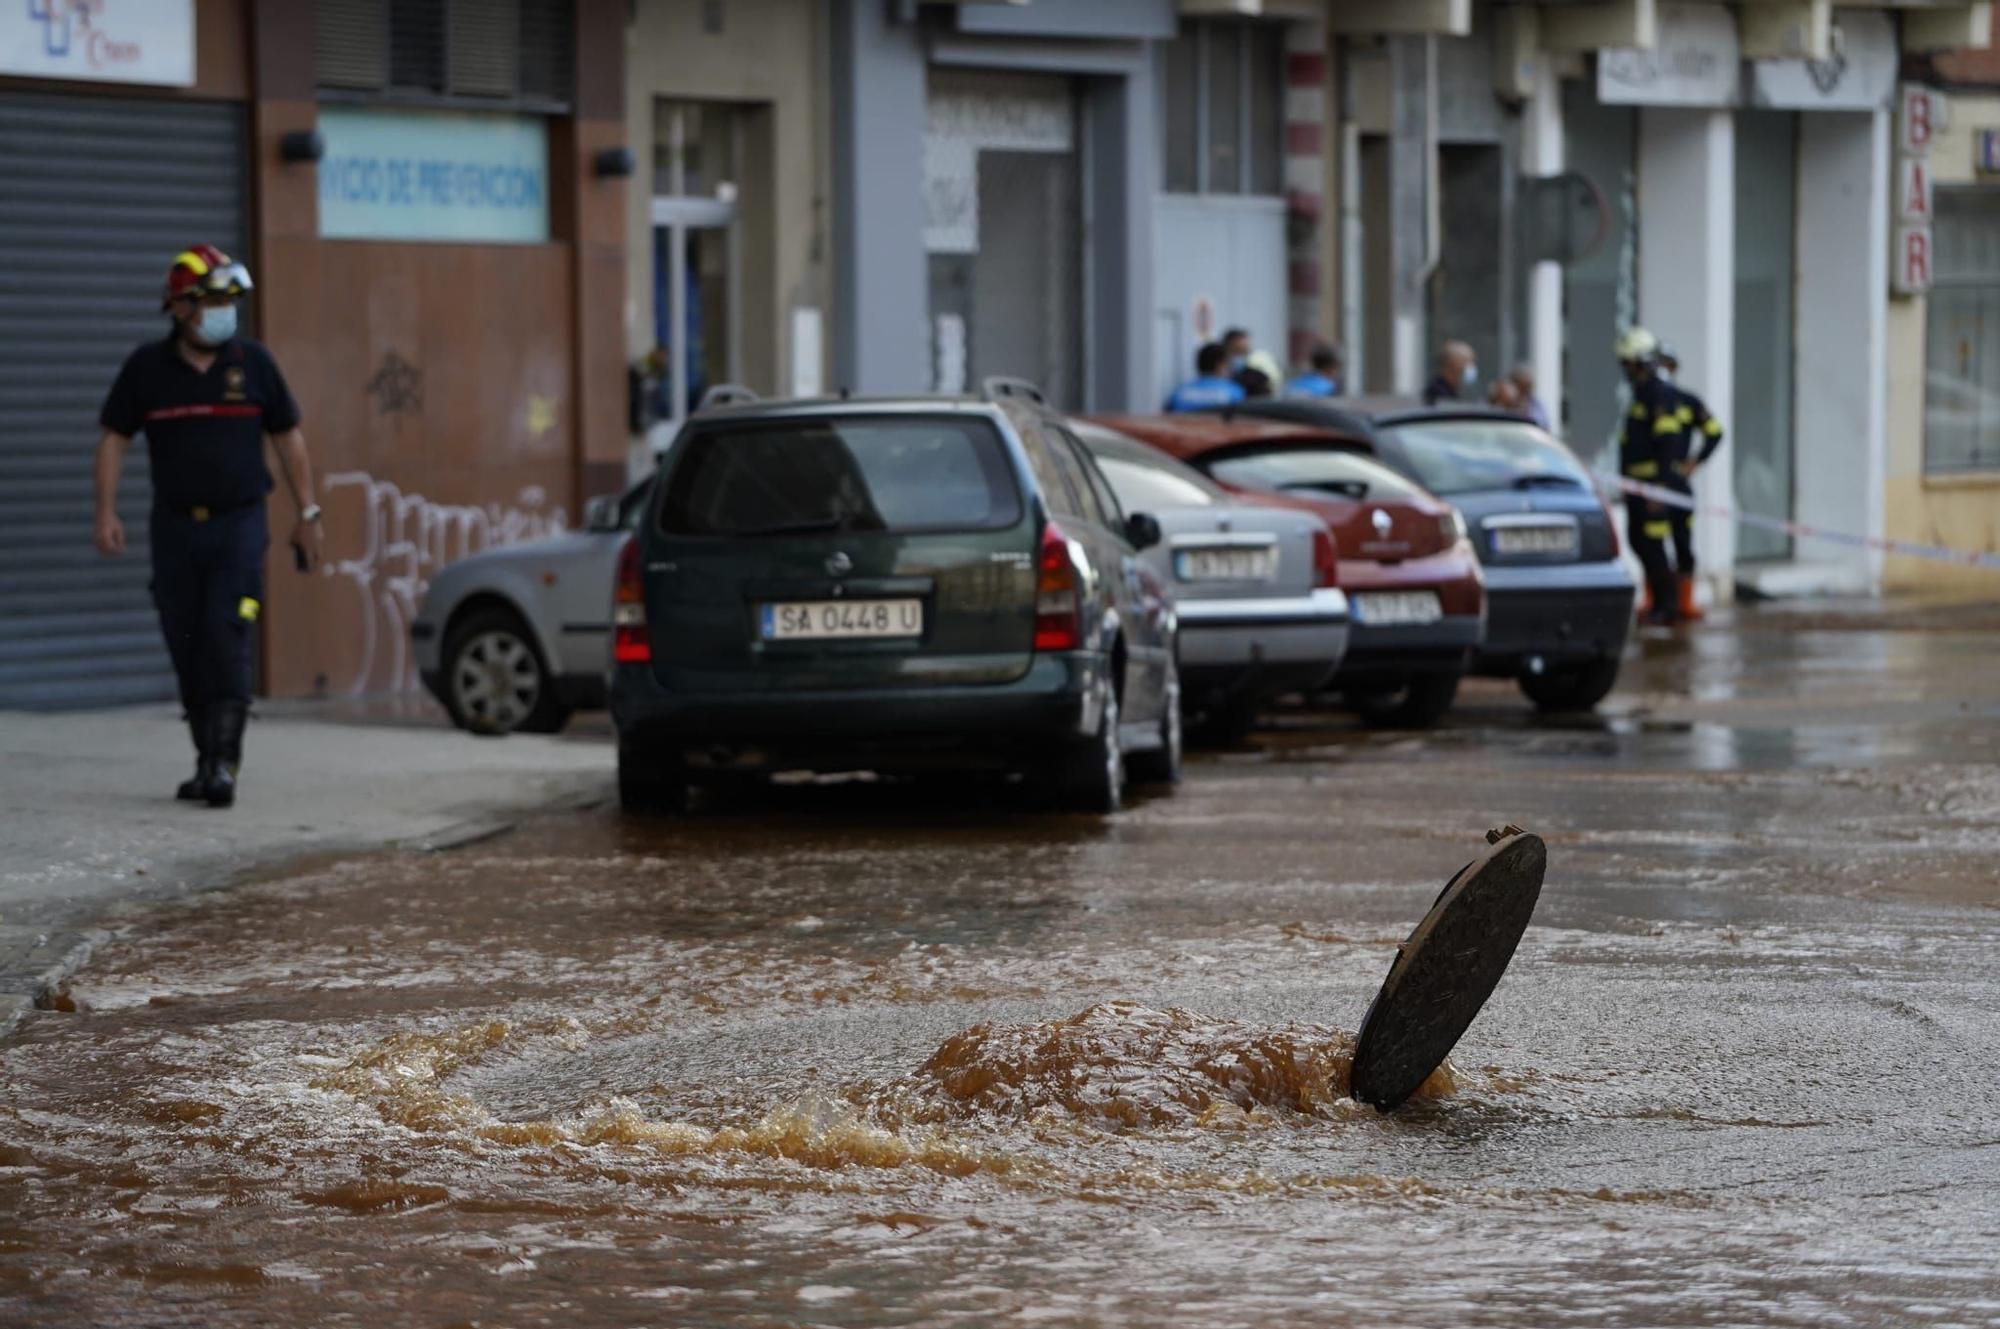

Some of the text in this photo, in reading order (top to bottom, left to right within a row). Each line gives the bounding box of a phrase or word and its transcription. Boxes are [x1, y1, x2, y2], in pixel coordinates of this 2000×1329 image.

[386, 158, 412, 206] DE
[1907, 92, 1931, 287] BAR
[781, 602, 917, 633] SA 0448 U
